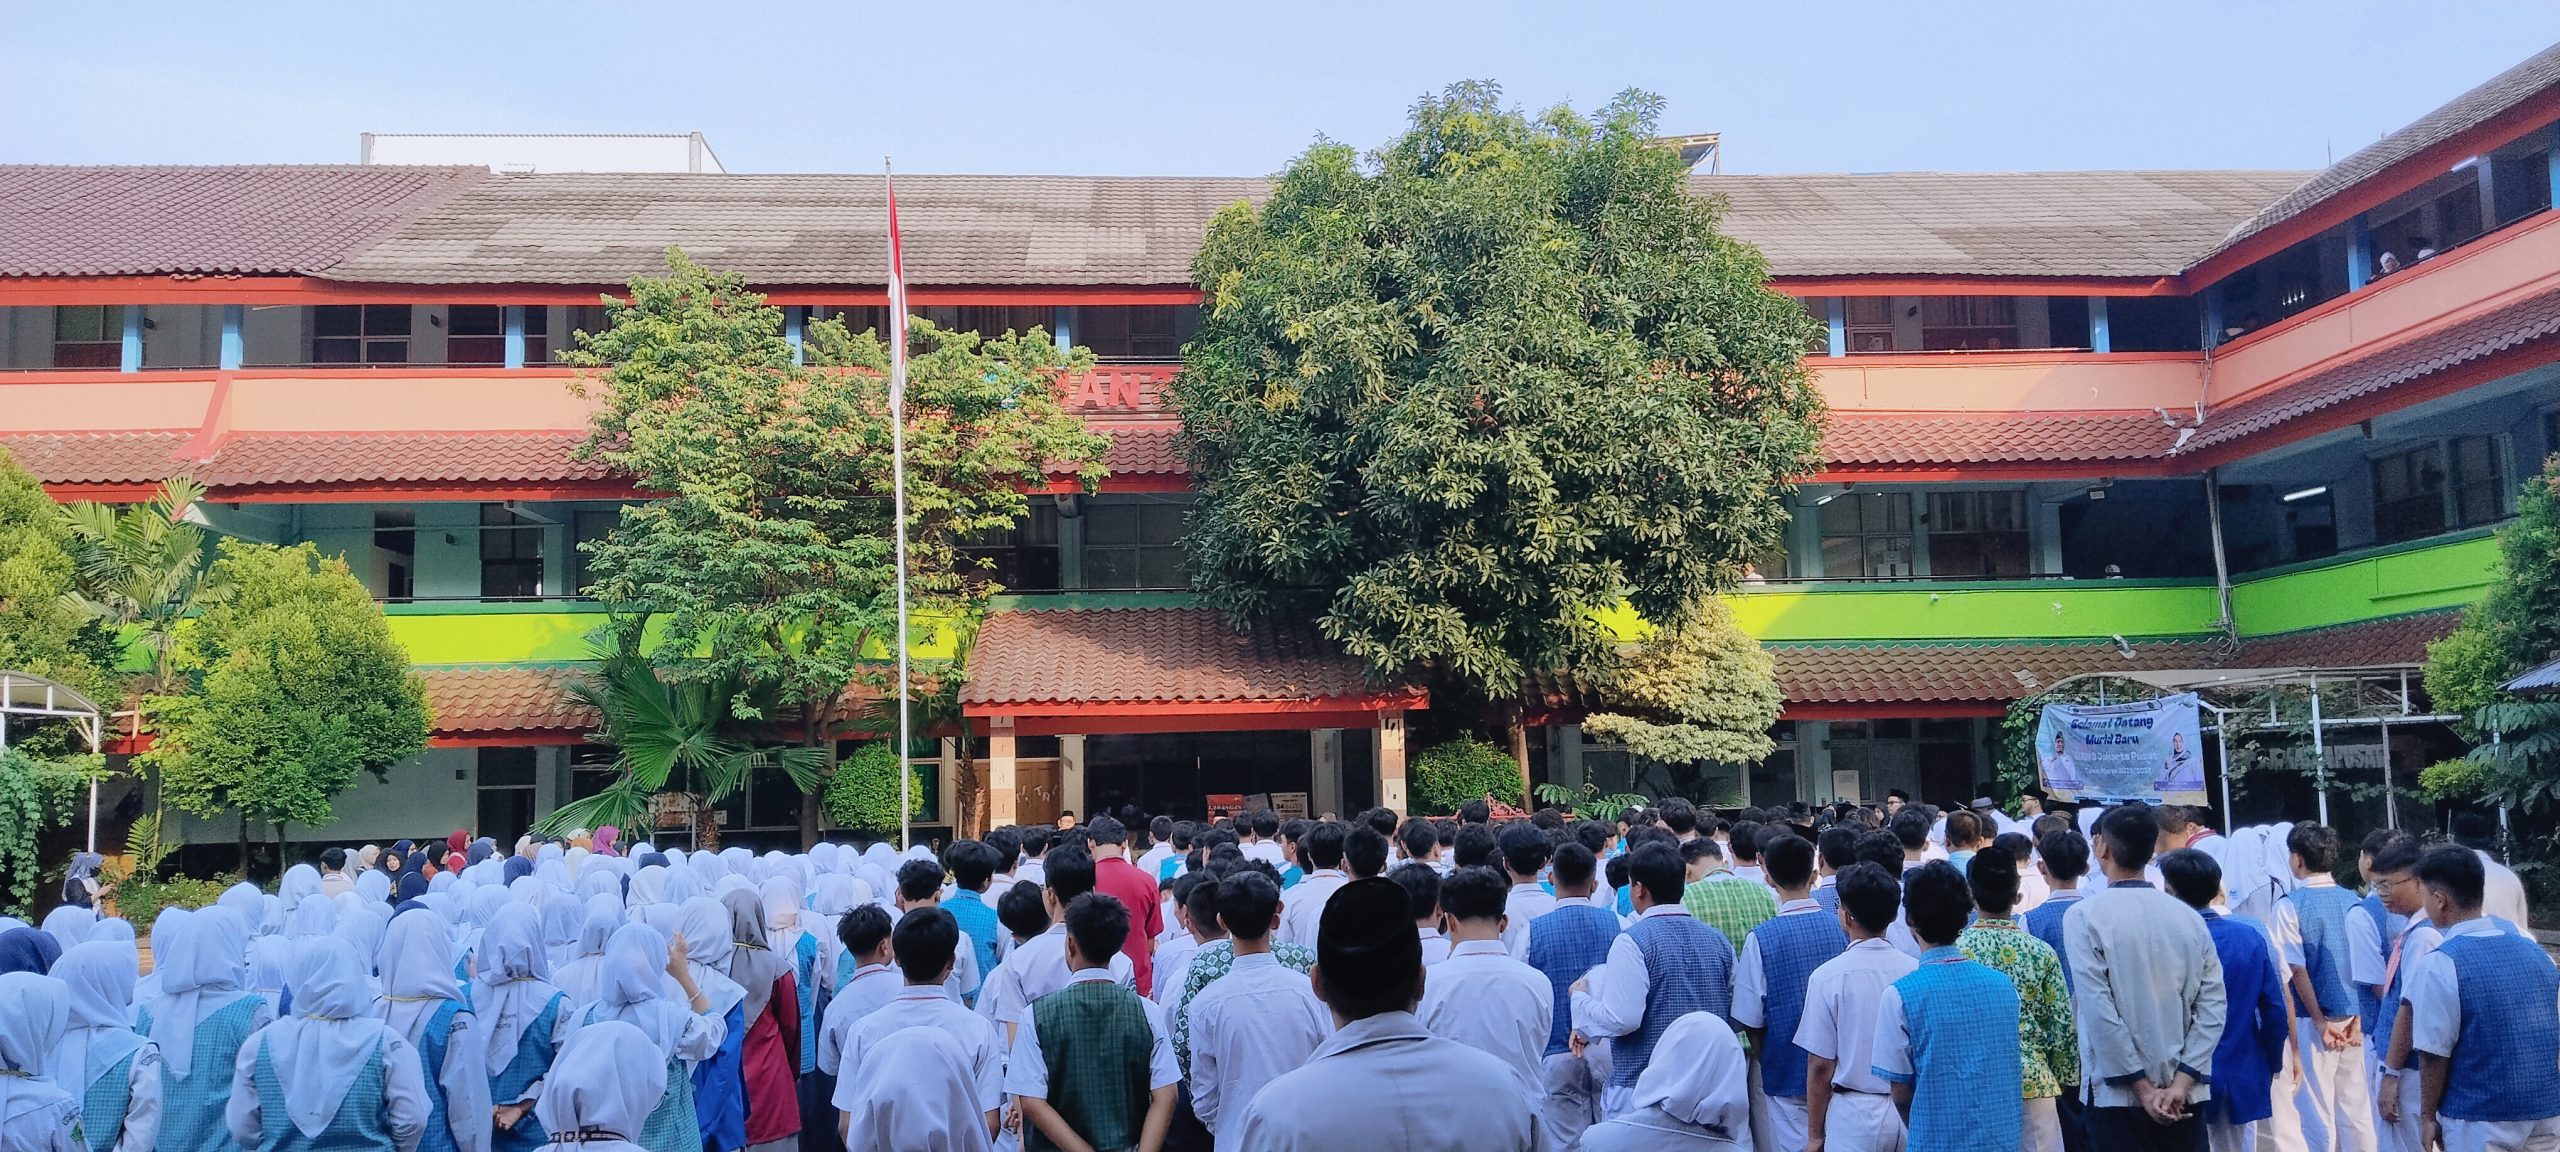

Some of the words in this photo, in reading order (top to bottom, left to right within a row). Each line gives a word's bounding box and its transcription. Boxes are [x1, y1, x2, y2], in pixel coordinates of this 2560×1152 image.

[2071, 718, 2113, 729] Selamat
[2114, 716, 2154, 730] Datang
[2085, 734, 2113, 745] Murid
[2115, 733, 2139, 745] Baru
[2130, 751, 2157, 761] Pusat
